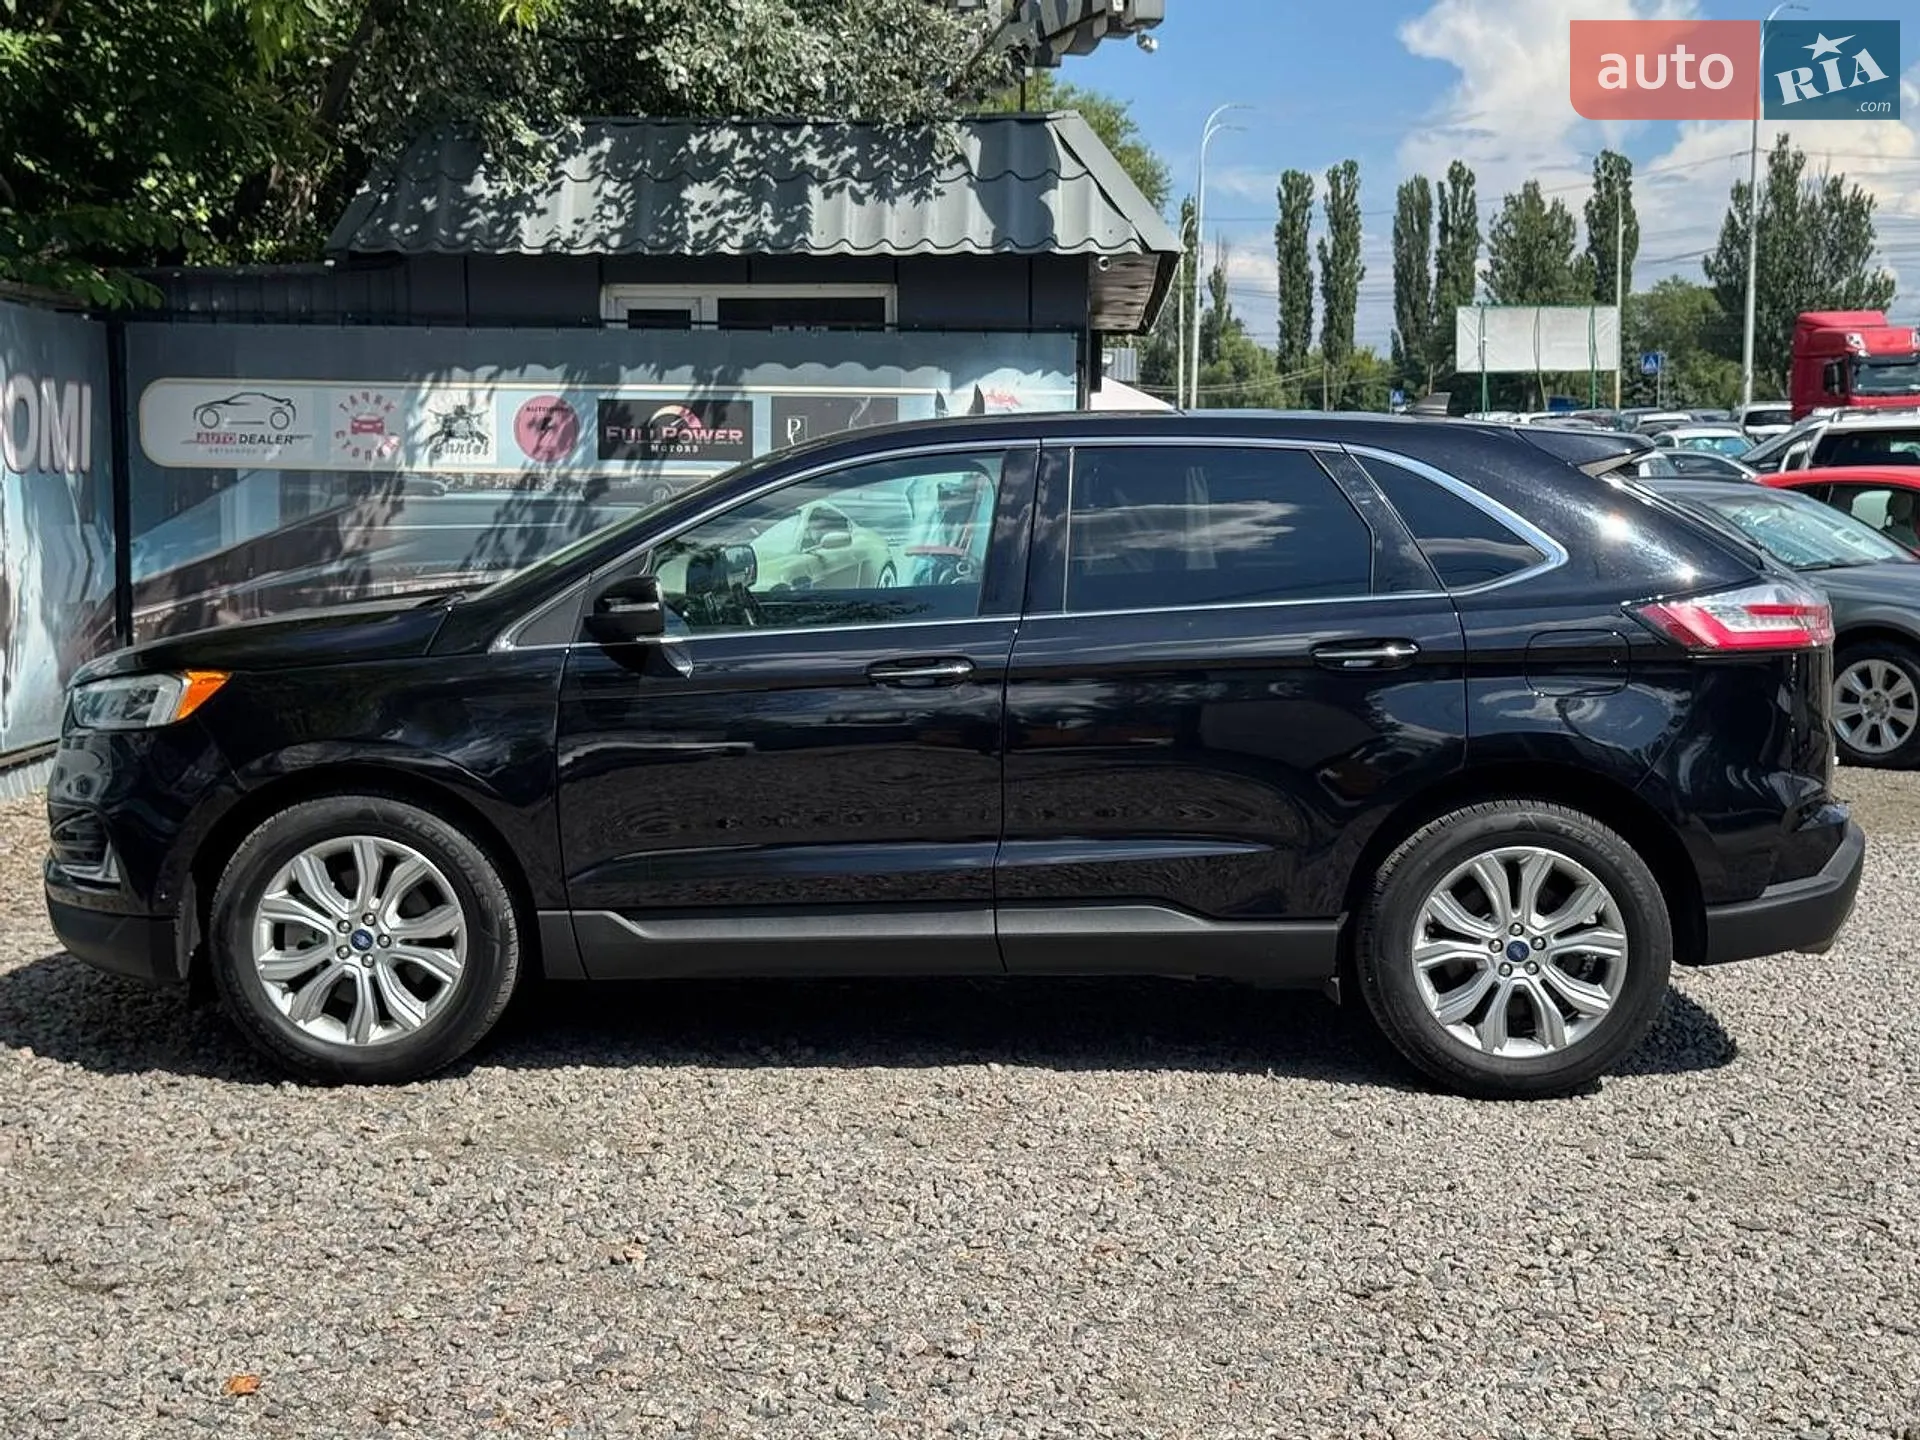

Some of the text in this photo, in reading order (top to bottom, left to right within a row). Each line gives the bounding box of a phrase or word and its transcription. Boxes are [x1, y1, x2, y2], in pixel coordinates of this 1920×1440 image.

[0, 374, 92, 472] OMI
[239, 433, 293, 446] DEALER
[650, 444, 699, 453] MOTORS
[1555, 821, 1622, 867] TERRA
